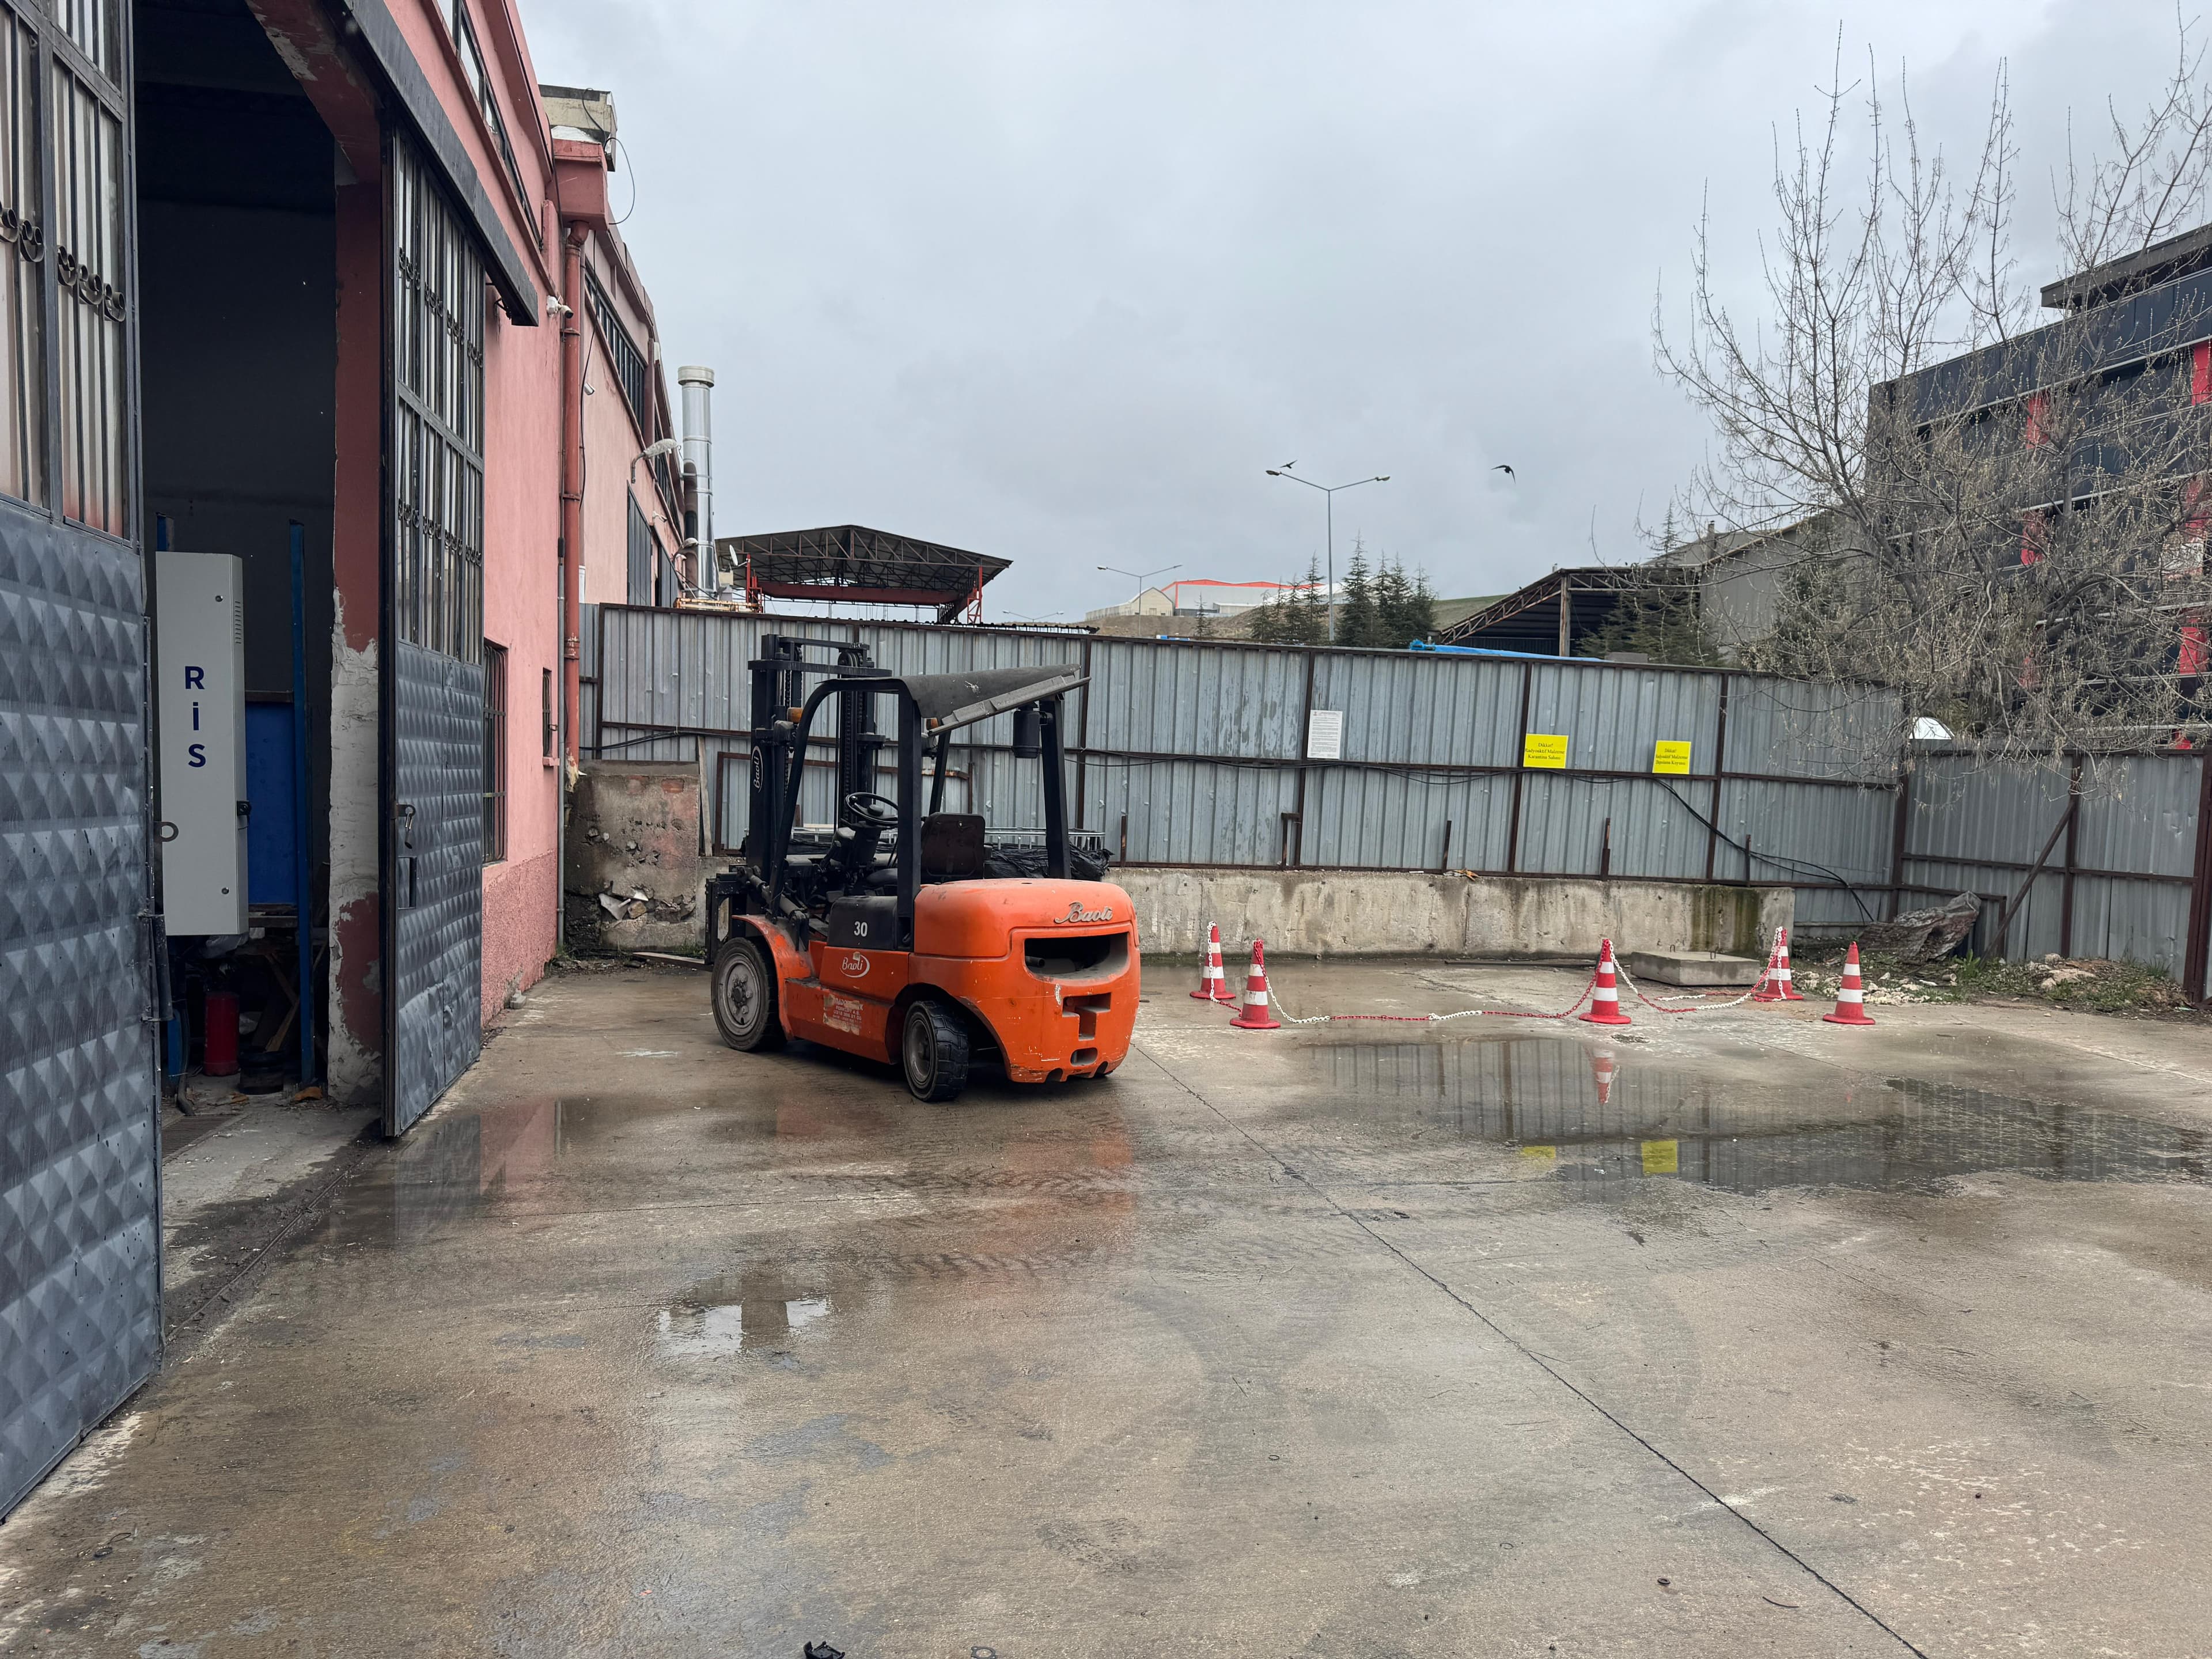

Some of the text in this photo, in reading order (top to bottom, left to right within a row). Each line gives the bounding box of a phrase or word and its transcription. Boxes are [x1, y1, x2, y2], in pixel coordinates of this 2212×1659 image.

[1054, 902, 1113, 924] Baoli
[854, 921, 868, 937] 30
[842, 957, 863, 970] Baoli
